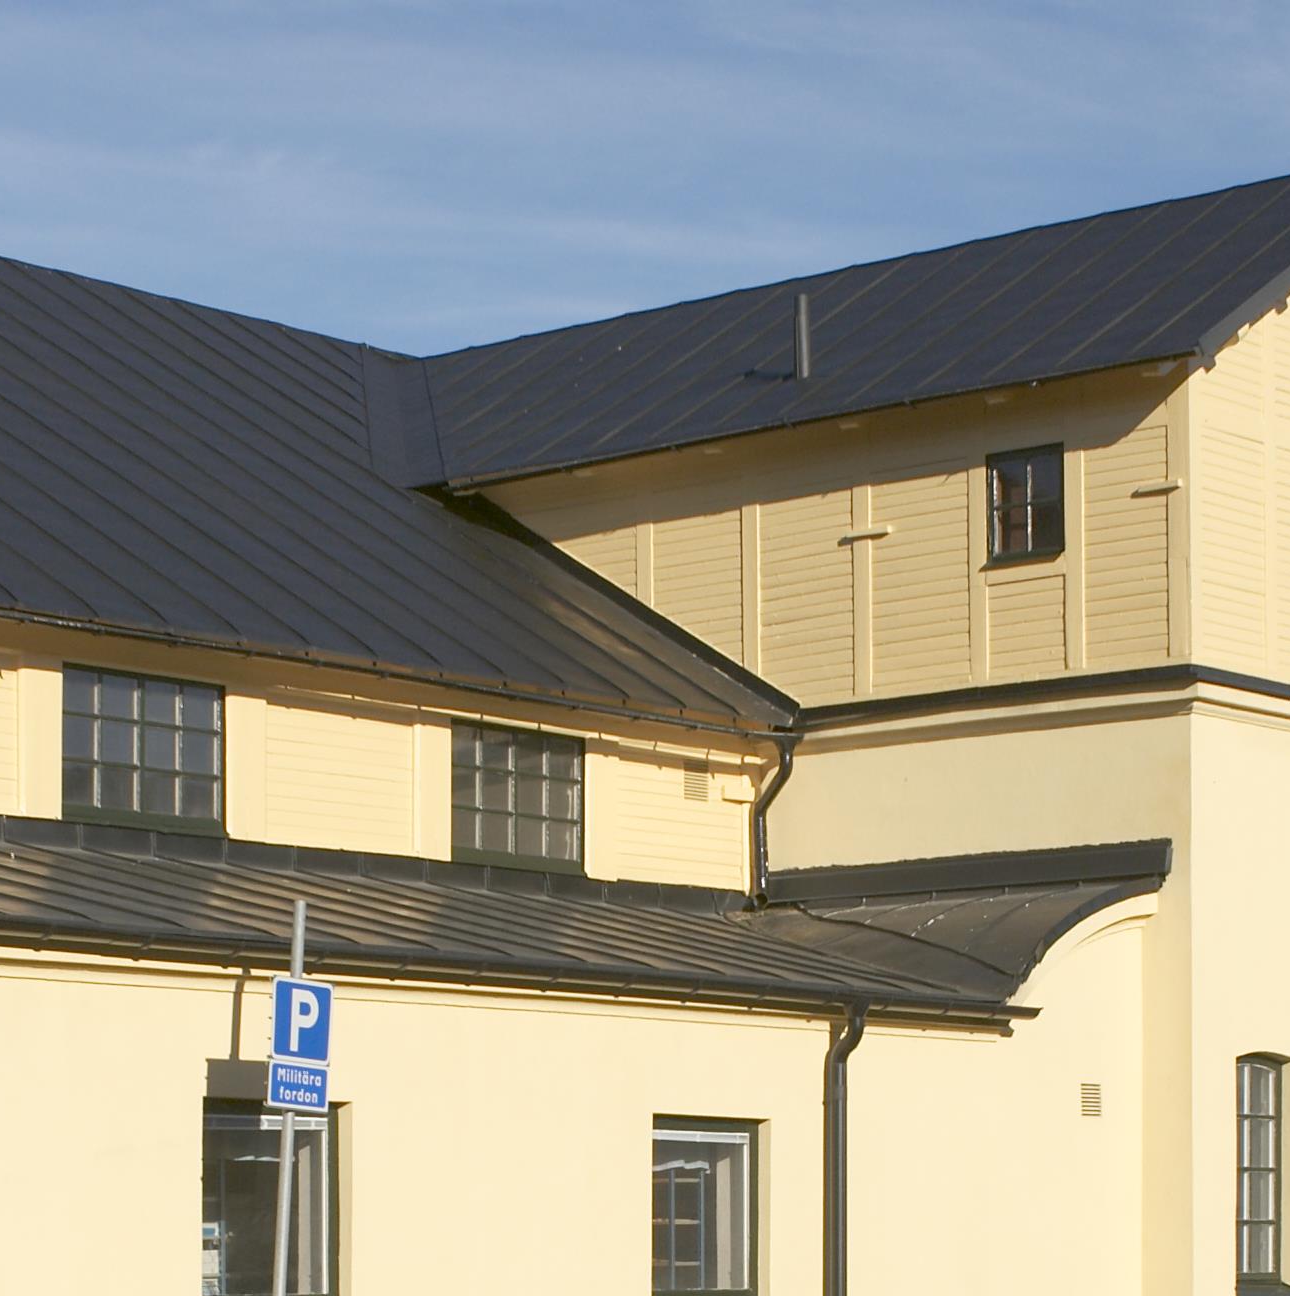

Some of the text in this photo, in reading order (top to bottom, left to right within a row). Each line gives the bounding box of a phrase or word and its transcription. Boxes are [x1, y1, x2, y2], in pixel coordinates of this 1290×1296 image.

[289, 988, 319, 1052] P
[277, 1067, 322, 1087] Militära
[279, 1086, 318, 1104] fordon
